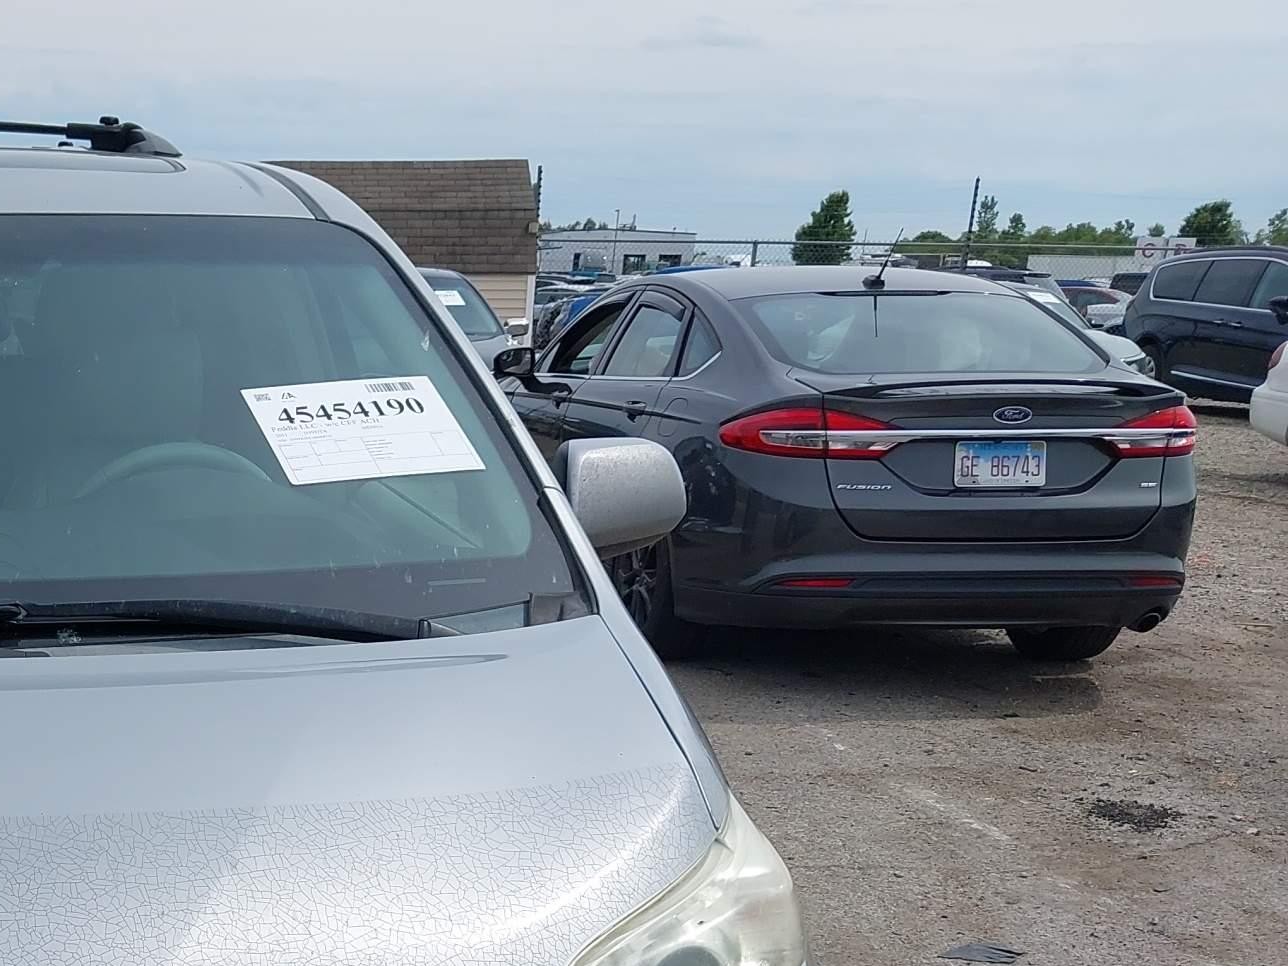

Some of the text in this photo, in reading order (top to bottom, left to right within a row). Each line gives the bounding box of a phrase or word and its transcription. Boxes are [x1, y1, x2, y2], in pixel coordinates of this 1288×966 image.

[278, 397, 424, 424] 45454190
[960, 455, 1040, 477] GE 86743
